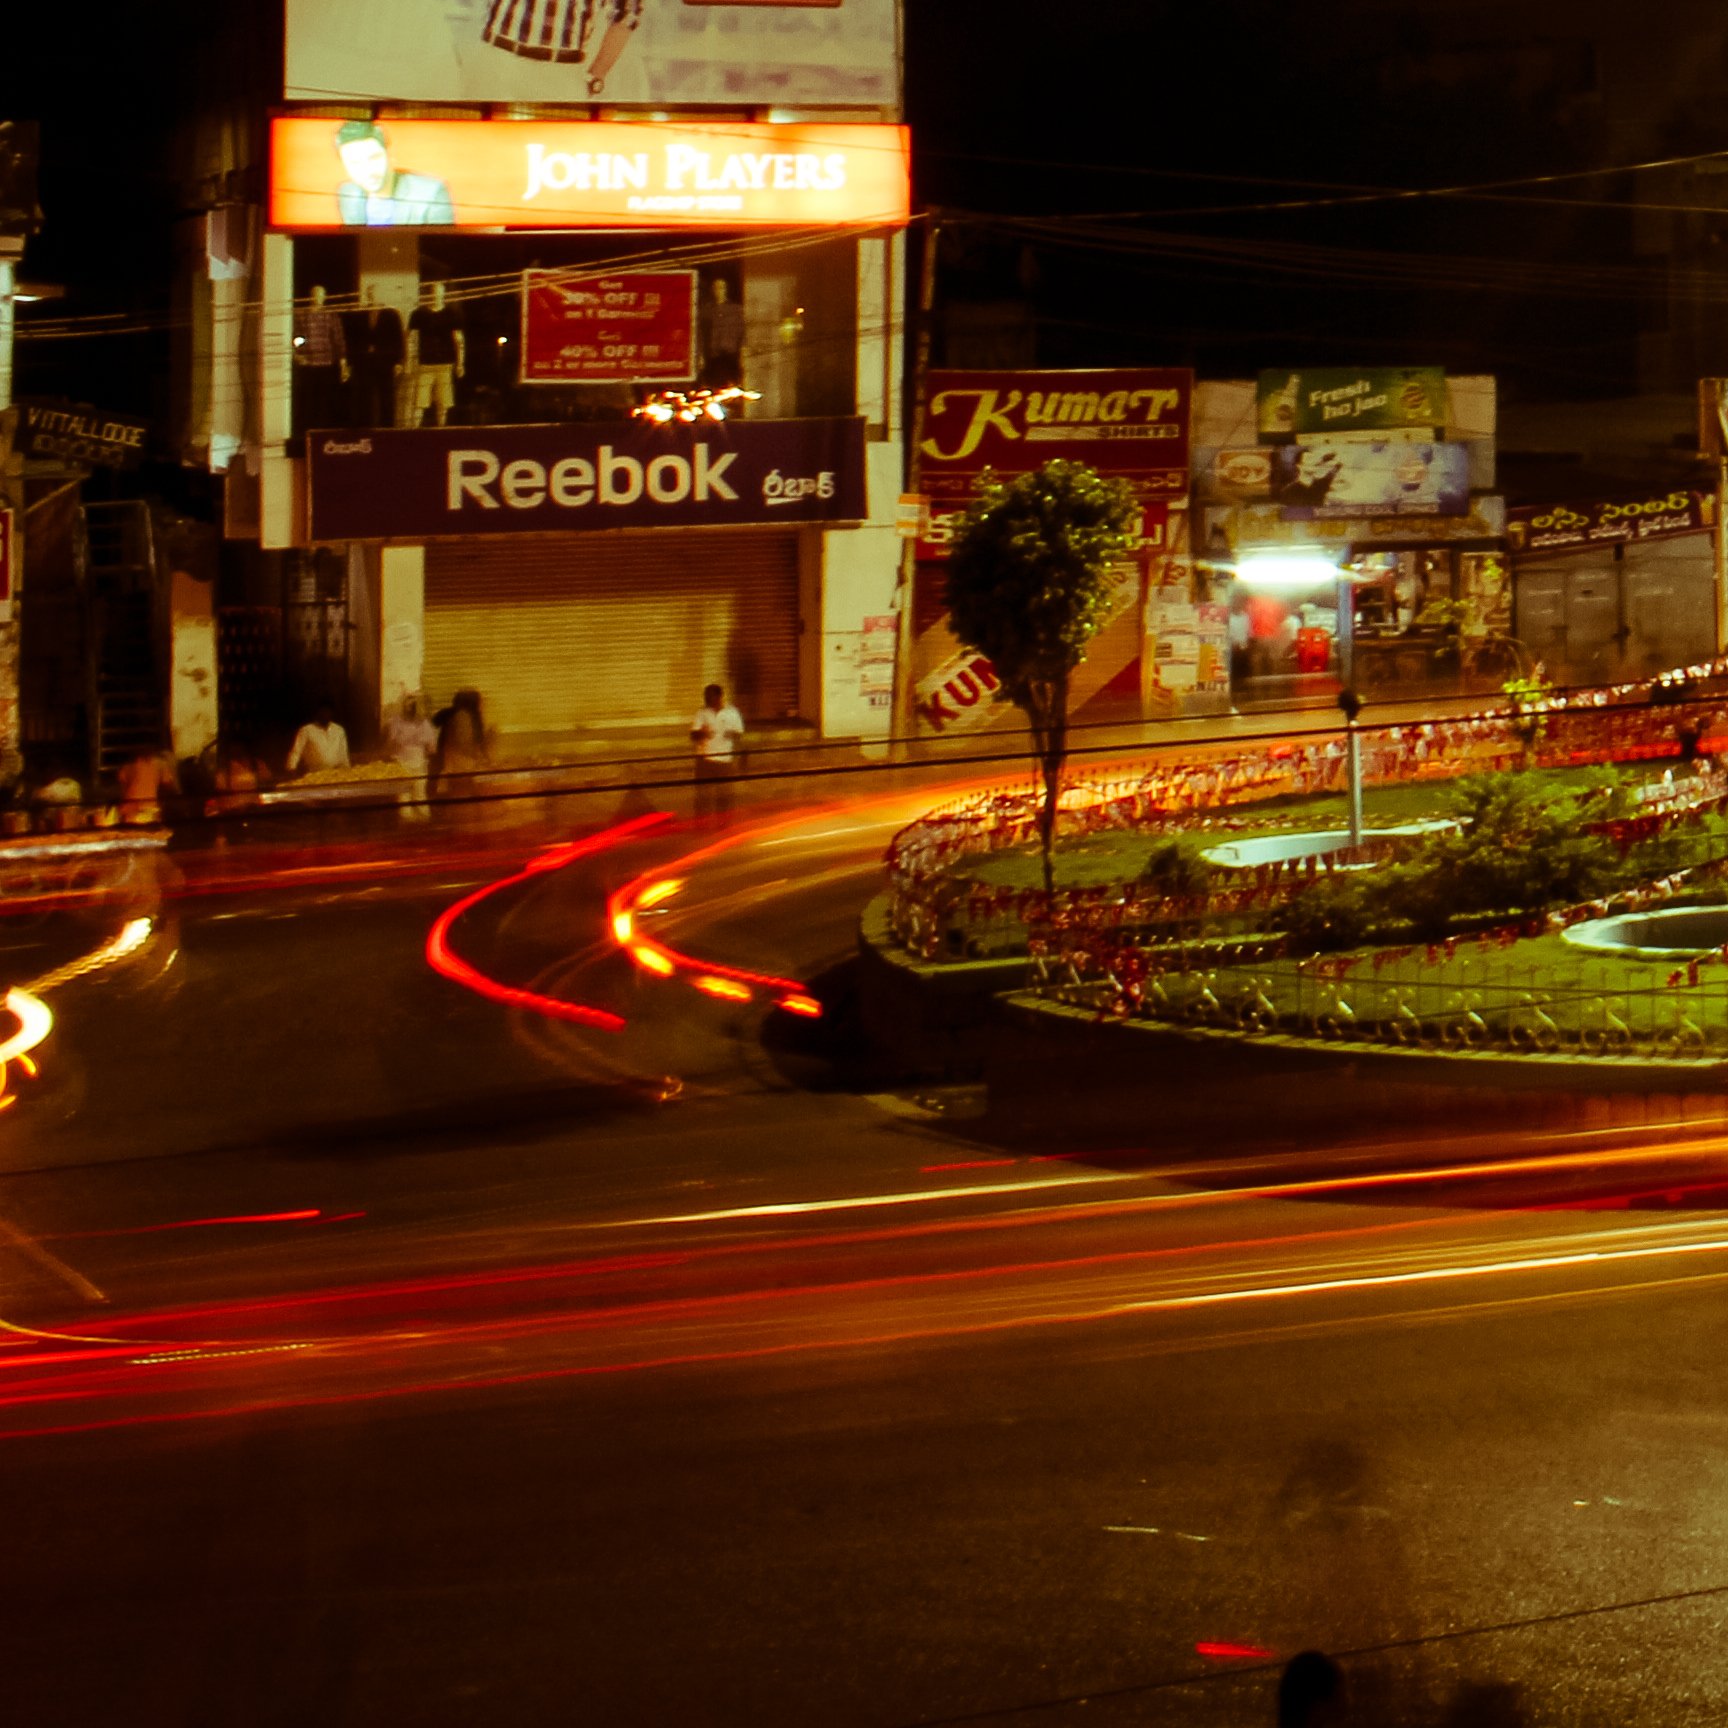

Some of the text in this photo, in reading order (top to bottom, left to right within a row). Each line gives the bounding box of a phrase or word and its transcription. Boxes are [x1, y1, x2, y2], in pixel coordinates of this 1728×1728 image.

[522, 143, 847, 200] JOHN PLAYERS
[604, 292, 638, 306] OFF
[602, 344, 638, 358] OFF
[447, 443, 739, 510] Reebok
